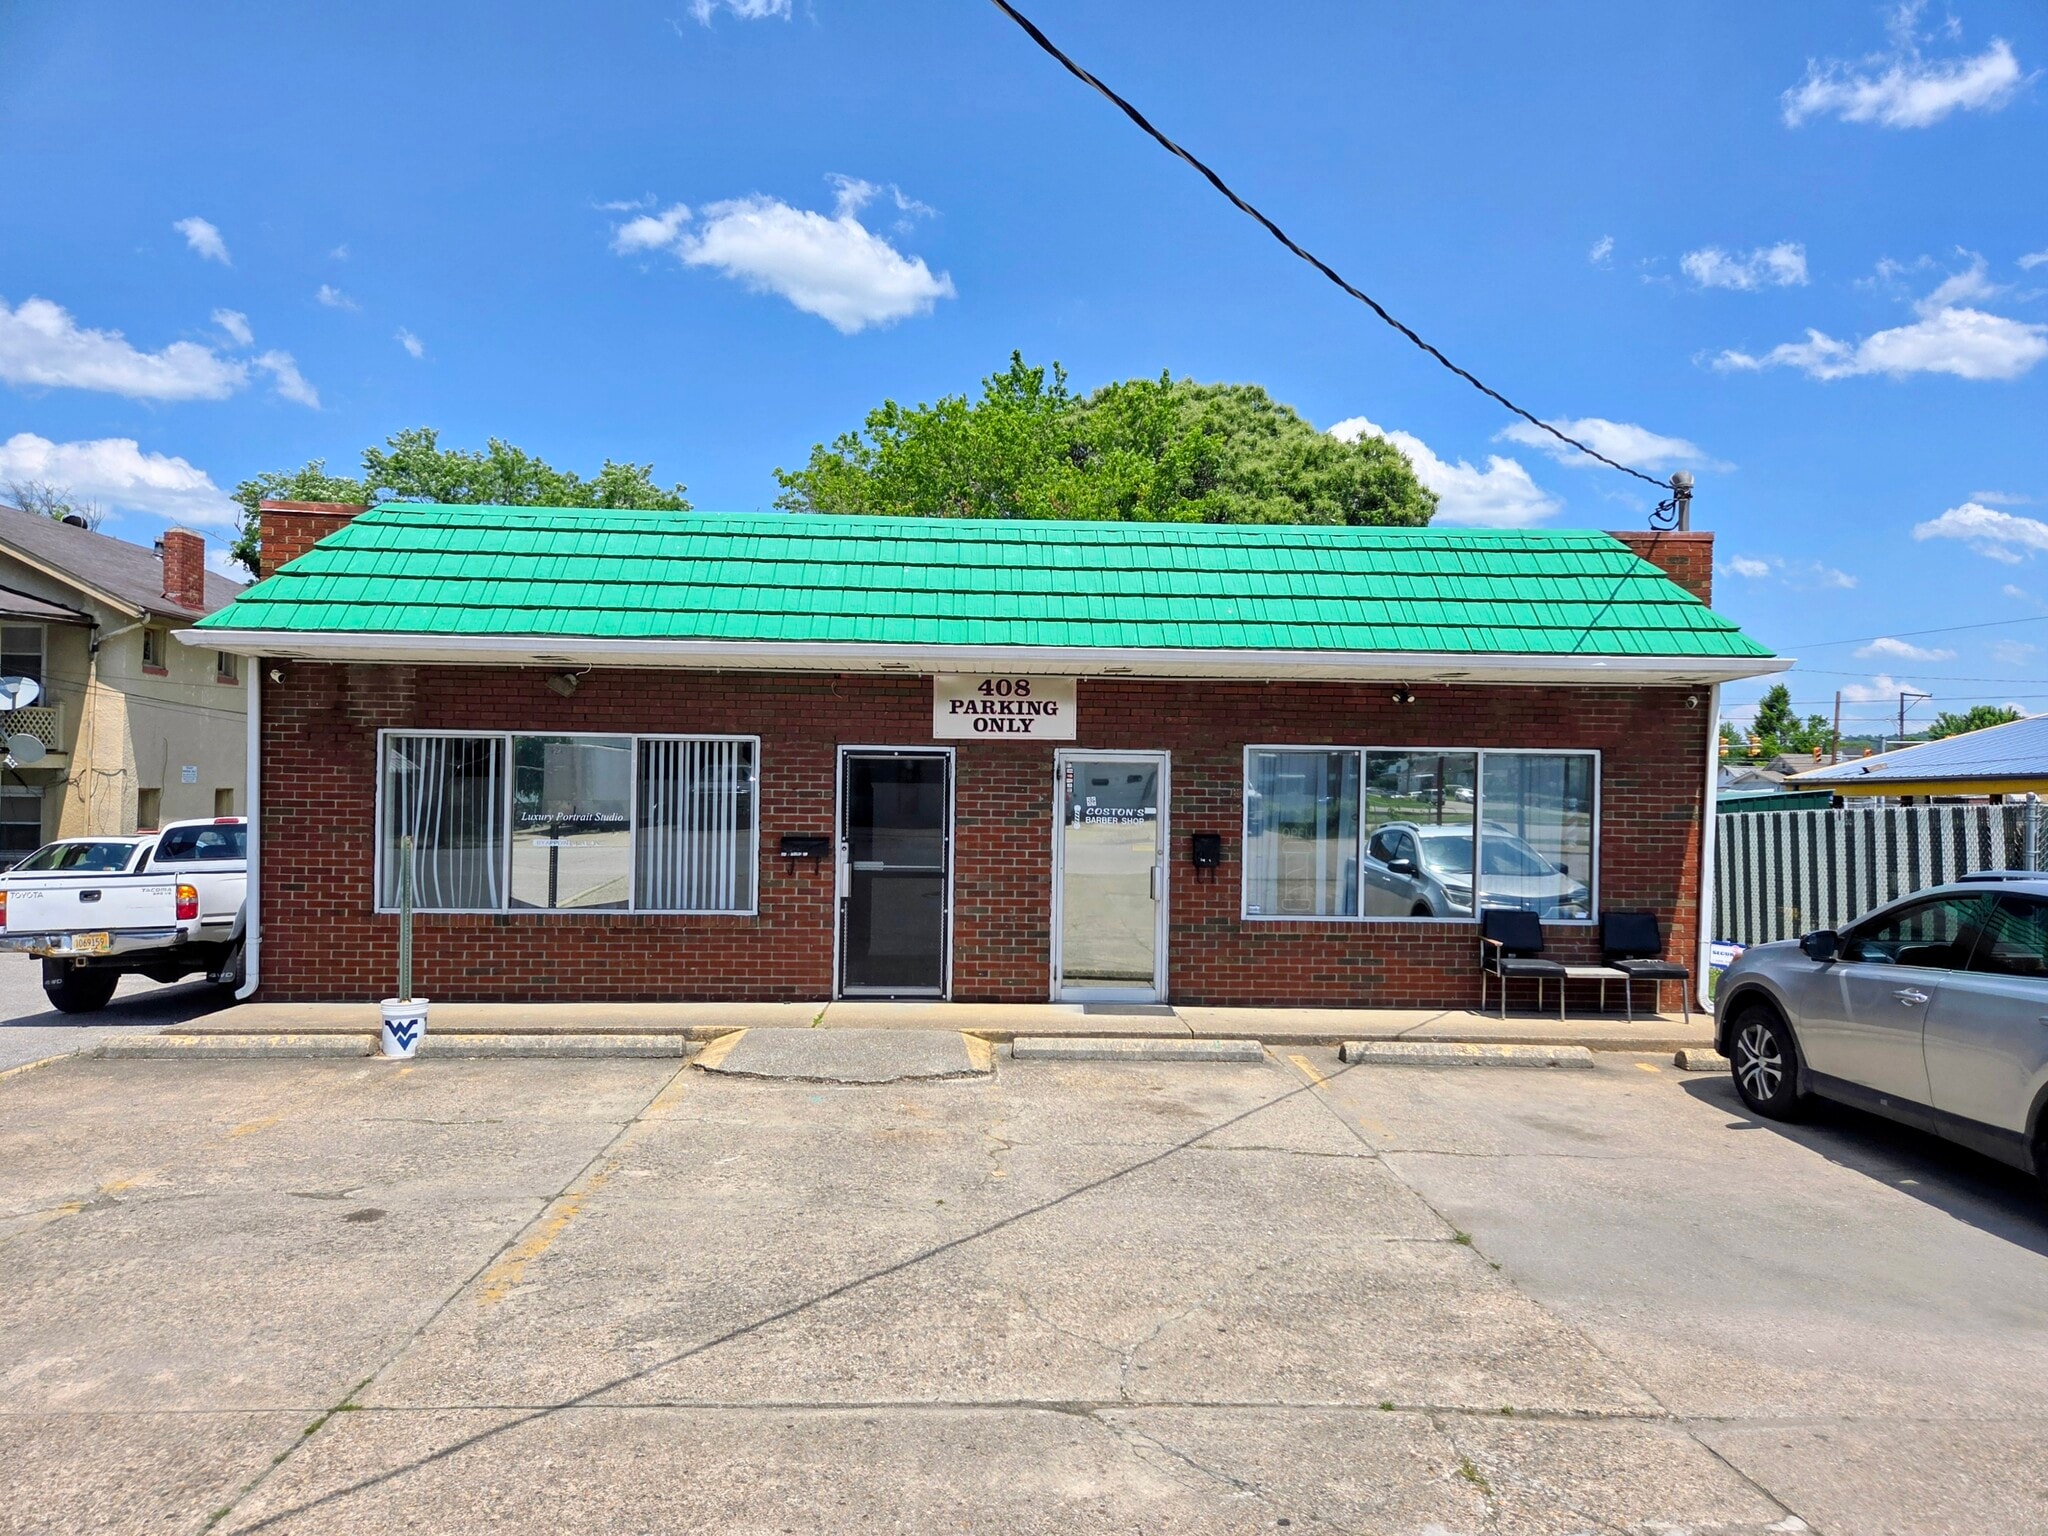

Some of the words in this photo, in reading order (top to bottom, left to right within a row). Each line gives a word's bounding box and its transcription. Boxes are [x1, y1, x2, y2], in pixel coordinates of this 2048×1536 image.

[977, 679, 1030, 697] 408
[949, 700, 1058, 716] PARKING
[973, 717, 1034, 733] ONLY
[521, 812, 554, 822] Luxury
[556, 812, 593, 821] Portrait
[595, 812, 623, 821] Studio
[1086, 807, 1145, 817] COSTON'S
[1085, 816, 1118, 824] BARBER
[1121, 817, 1145, 825] SHOP
[10, 891, 44, 899] TOYOTA
